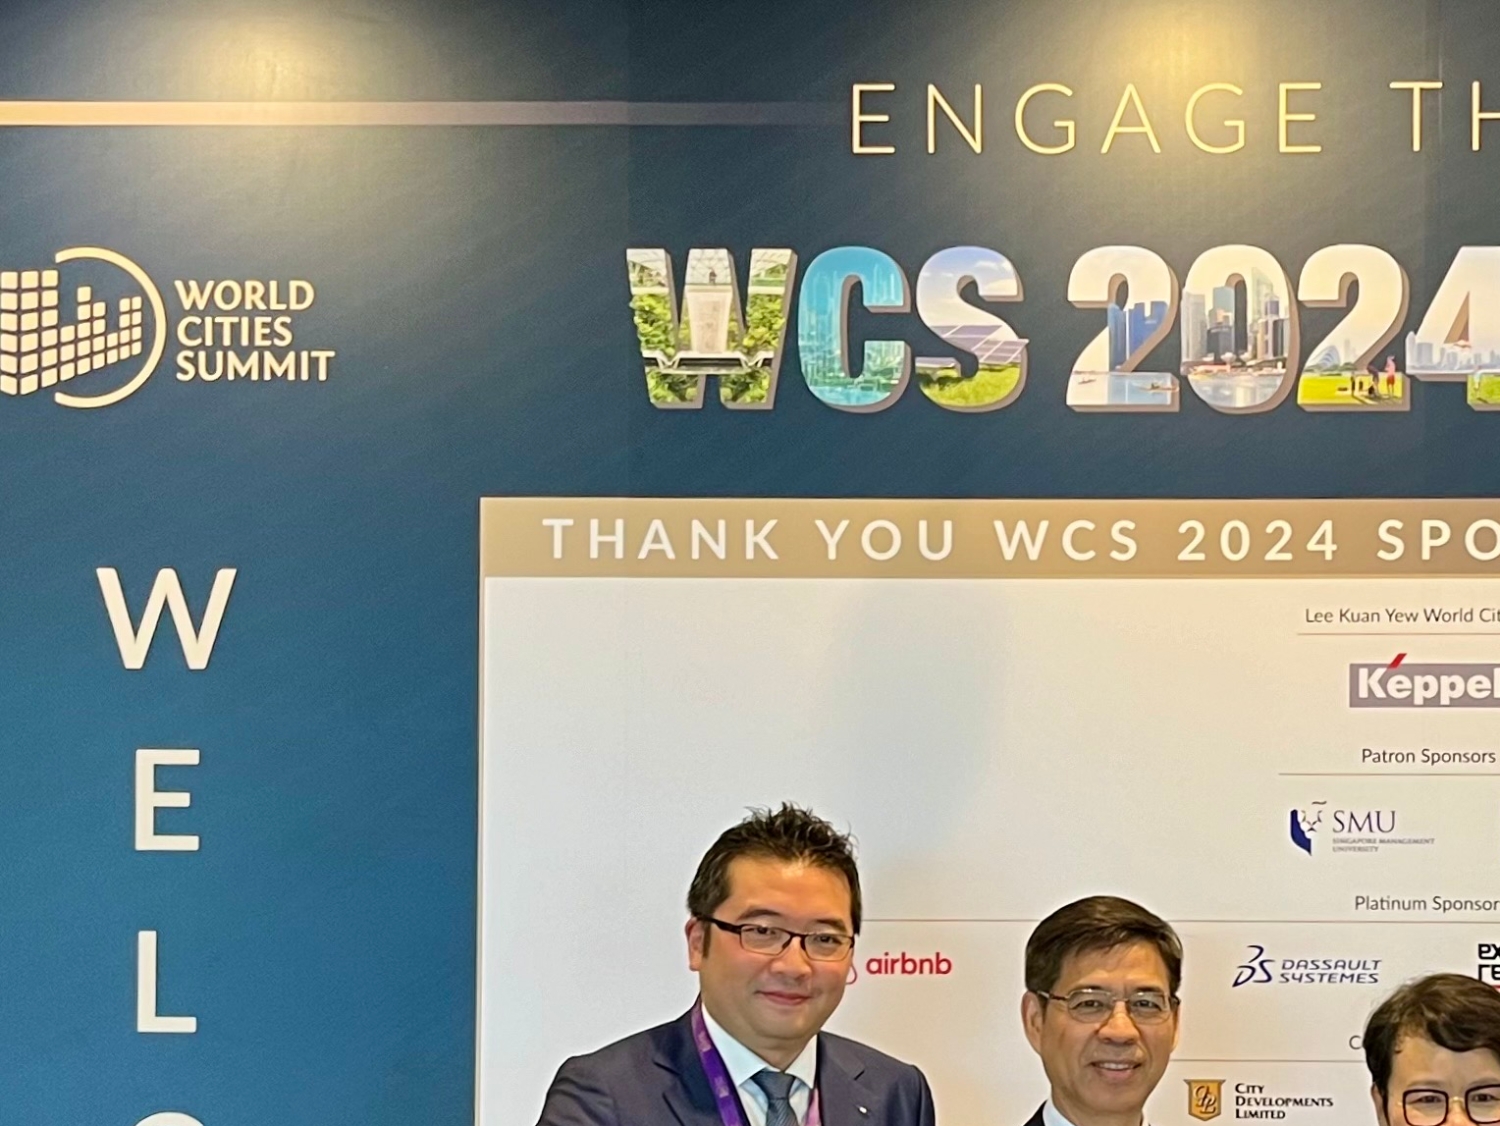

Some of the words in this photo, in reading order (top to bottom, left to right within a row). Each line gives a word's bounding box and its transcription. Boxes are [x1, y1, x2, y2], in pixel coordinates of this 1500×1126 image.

[851, 82, 1322, 154] ENGAGE
[174, 279, 315, 312] WORLD
[176, 315, 293, 348] CITIES
[625, 245, 1029, 414] WCS
[175, 350, 335, 383] SUMMIT
[542, 517, 781, 560] THANK
[814, 519, 956, 562] YOU
[994, 519, 1139, 562] WCS
[1177, 519, 1338, 561] 2024
[1305, 608, 1334, 623] Lee
[1339, 608, 1381, 623] Kuan
[1385, 608, 1418, 623] Yew
[1423, 607, 1474, 623] World
[1361, 748, 1416, 764] Patron
[1421, 748, 1497, 766] Sponsors
[1332, 809, 1397, 833] SMU
[1355, 895, 1428, 911] Platinum
[866, 951, 952, 976] airbnb
[1281, 959, 1382, 971] DASSAULT
